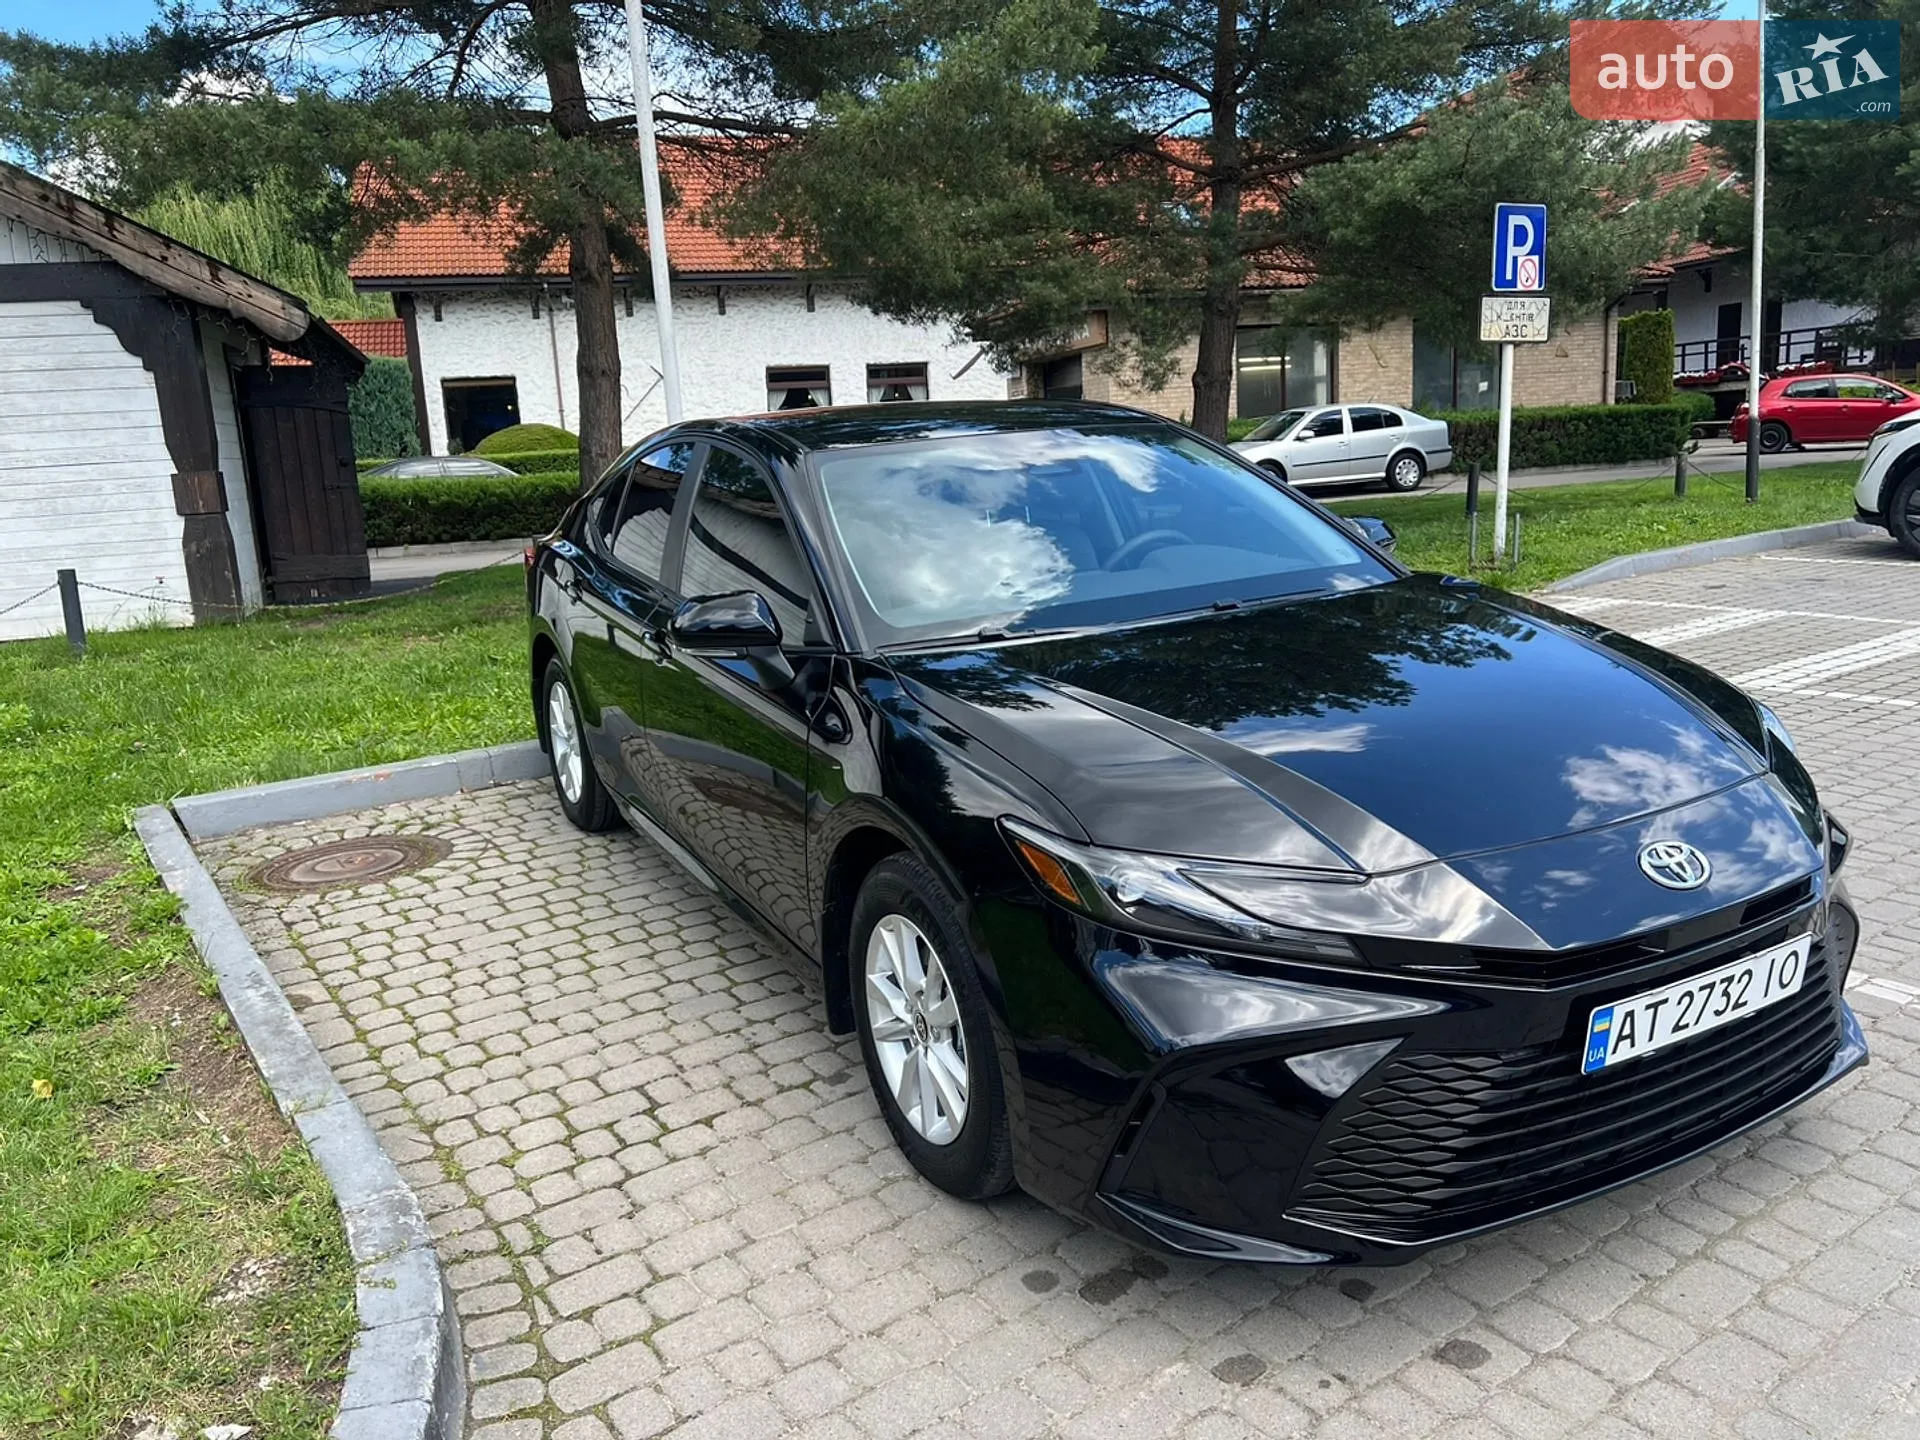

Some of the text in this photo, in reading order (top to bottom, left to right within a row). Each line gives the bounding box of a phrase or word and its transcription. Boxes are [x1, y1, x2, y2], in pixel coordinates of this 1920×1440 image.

[1506, 215, 1534, 280] P
[1503, 324, 1528, 338] АЗС
[1611, 949, 1800, 1056] AT 2732 IO
[1588, 1048, 1605, 1063] UA
